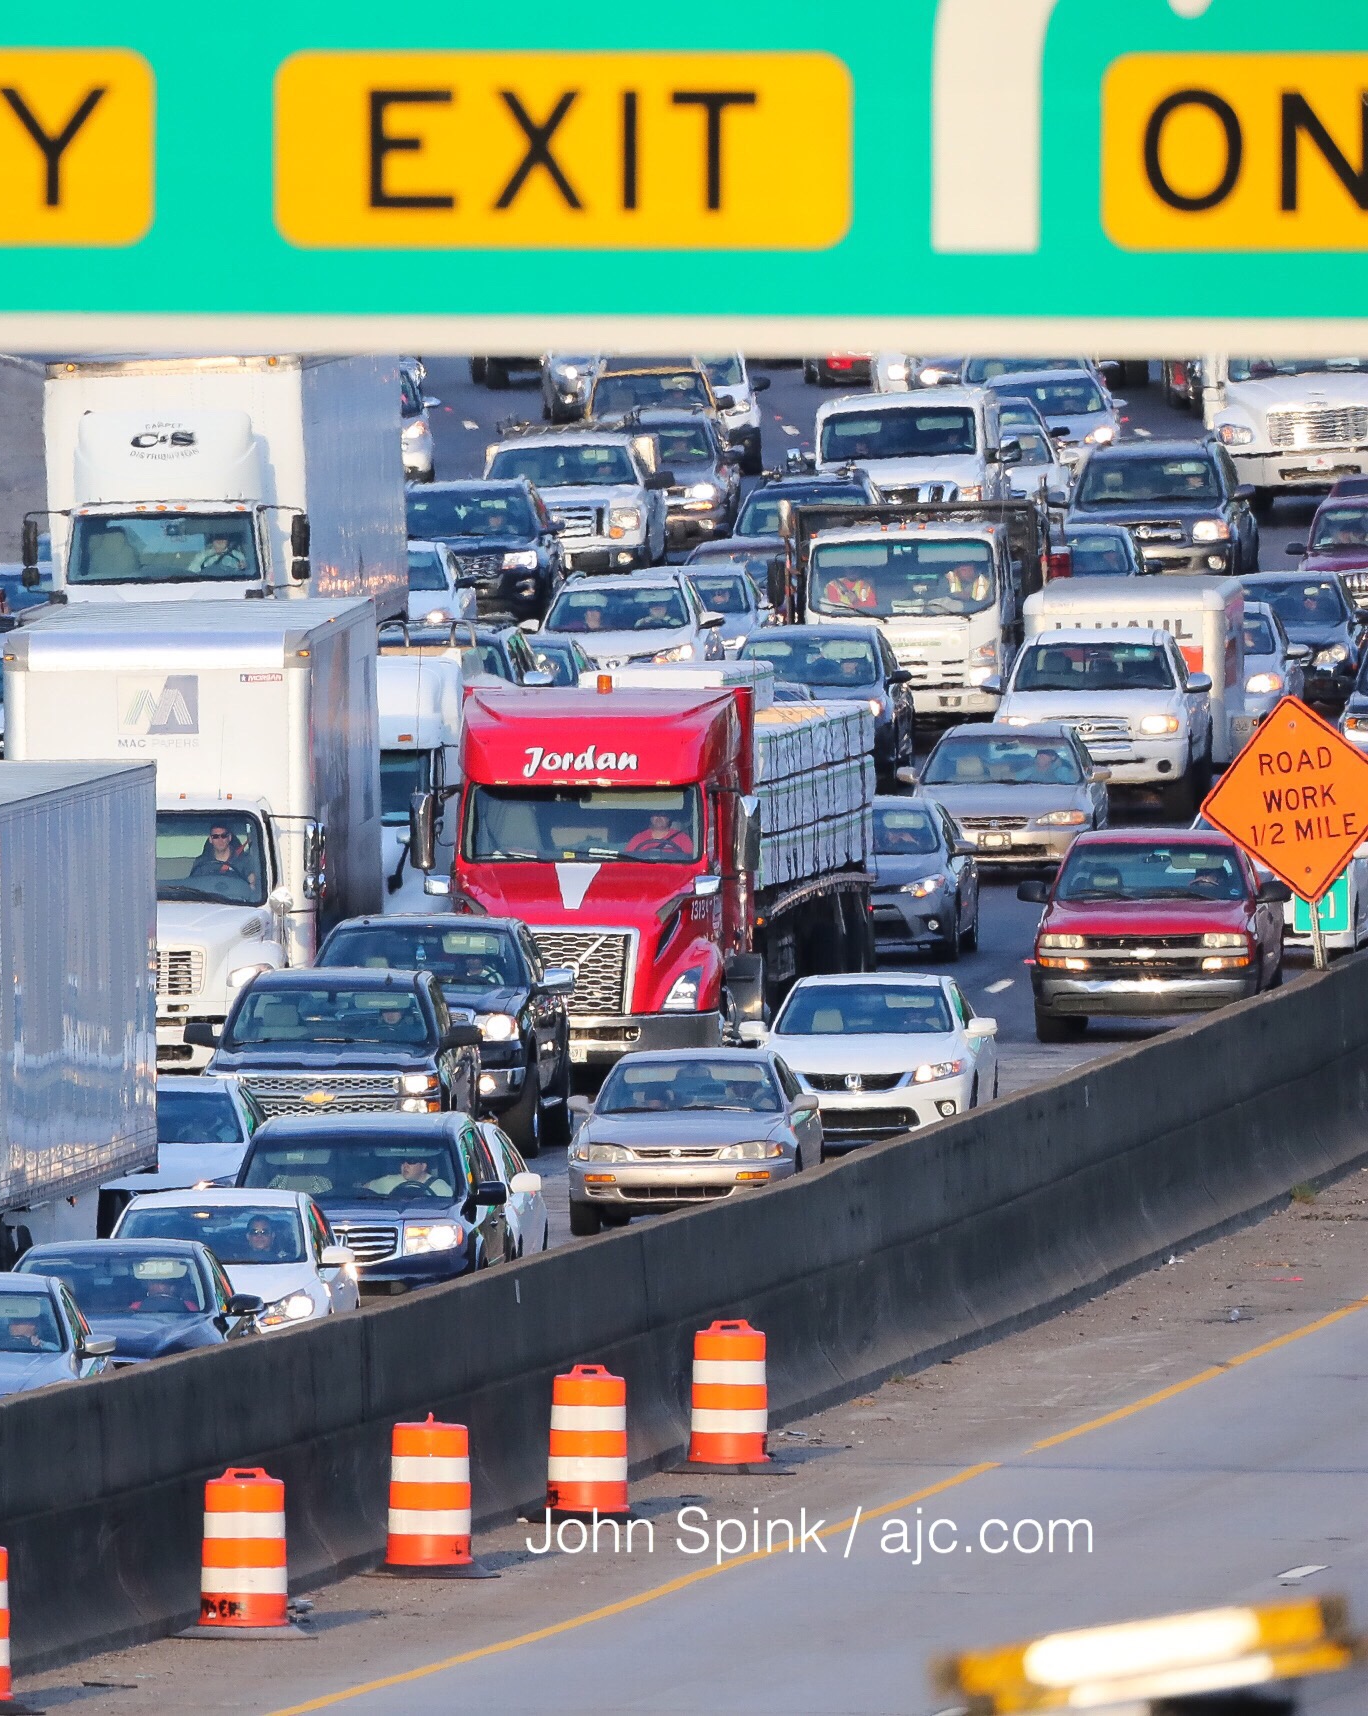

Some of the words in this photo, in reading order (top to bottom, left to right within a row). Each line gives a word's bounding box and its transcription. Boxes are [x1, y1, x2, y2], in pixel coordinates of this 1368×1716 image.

[368, 89, 758, 211] EXIT
[118, 739, 146, 748] MAC
[523, 745, 638, 778] Jordan
[1258, 746, 1333, 776] ROAD
[1262, 783, 1337, 814] WORK
[1250, 822, 1286, 847] 1/2
[1294, 812, 1359, 842] MILE
